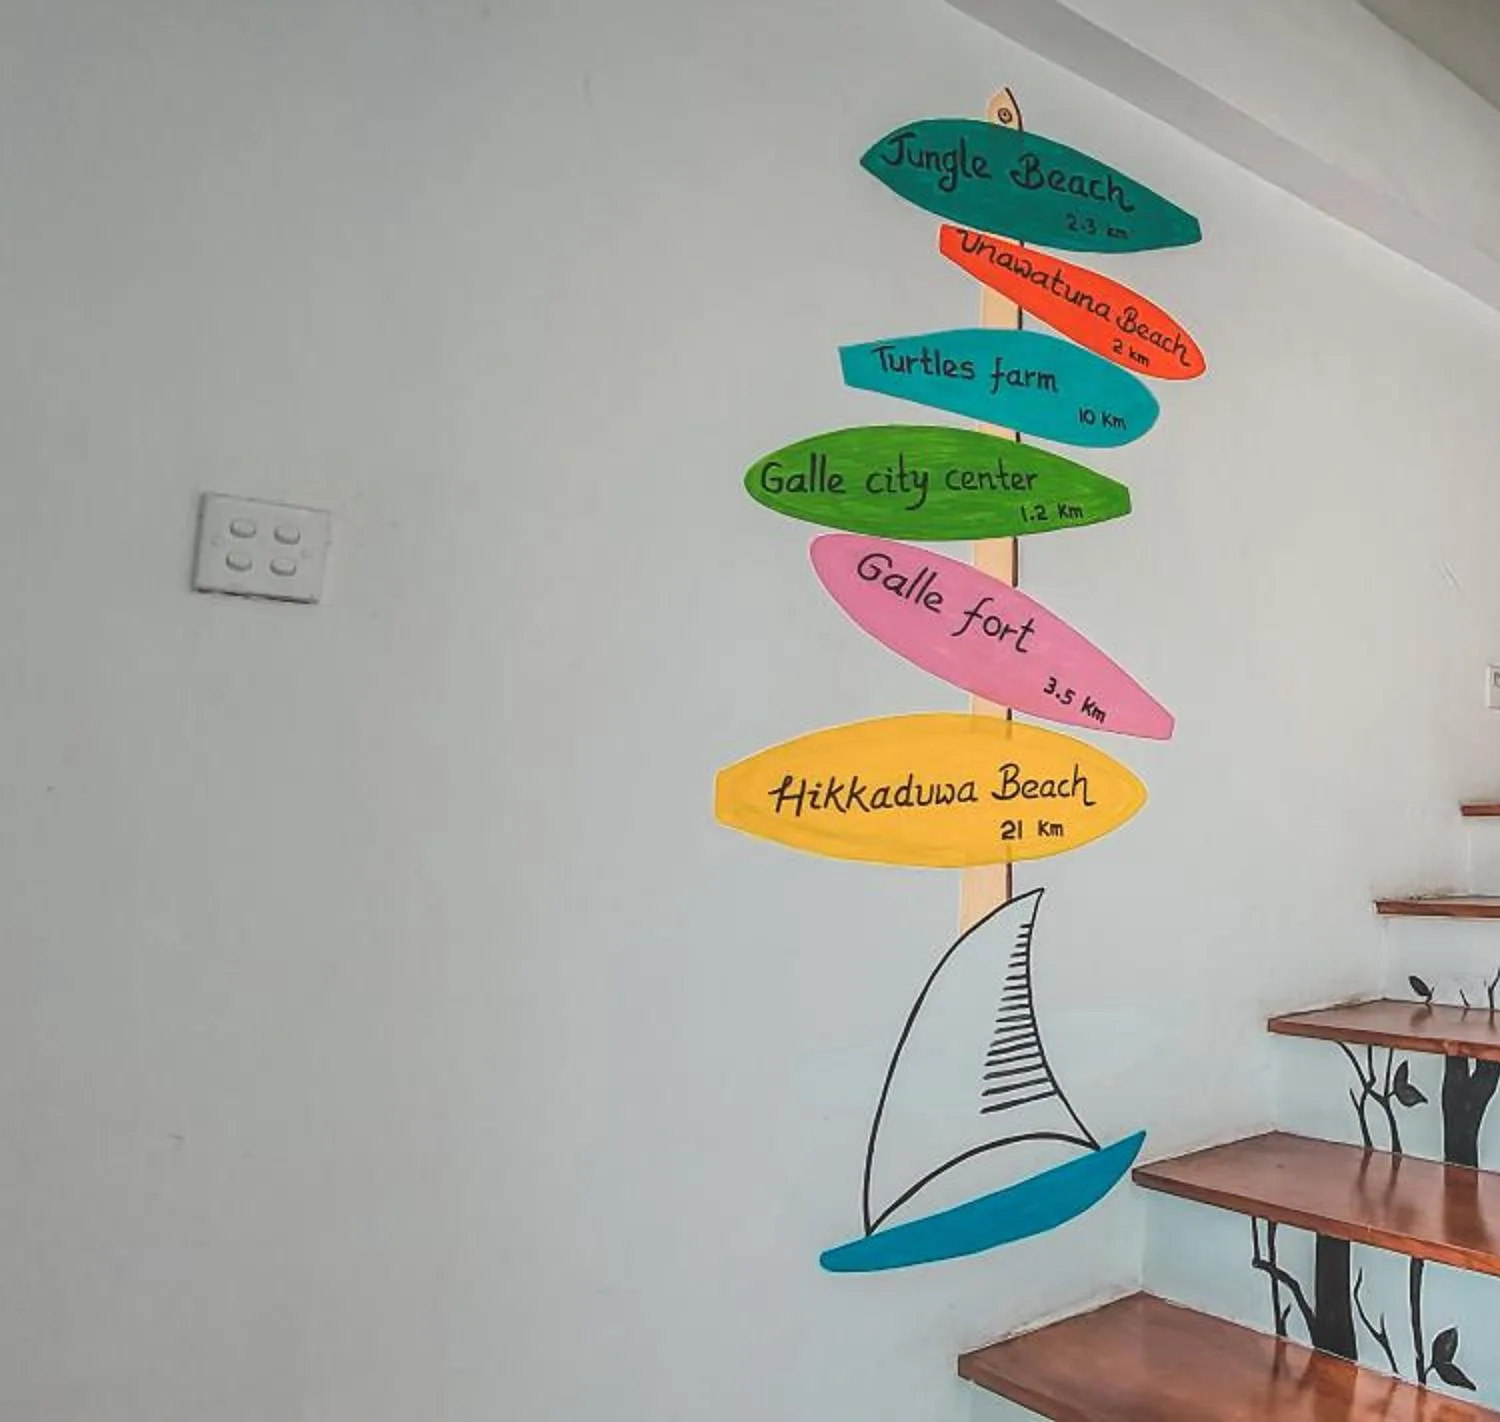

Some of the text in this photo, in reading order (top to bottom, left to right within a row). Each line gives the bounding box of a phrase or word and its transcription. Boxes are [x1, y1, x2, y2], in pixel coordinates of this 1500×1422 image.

[880, 132, 1135, 212] Jungle Beach
[957, 229, 1191, 367] Unawatuna Beach
[871, 345, 1058, 394] Turtles farm
[1112, 338, 1123, 354] 2
[1078, 408, 1096, 426] 10
[761, 453, 1038, 510] Galle city center
[1020, 505, 1049, 522] 1.2
[857, 553, 1035, 653] Galle fort
[1043, 677, 1076, 705] 3.5
[768, 763, 1097, 817] Hikkaduwa Beach
[1001, 820, 1023, 840] 21
